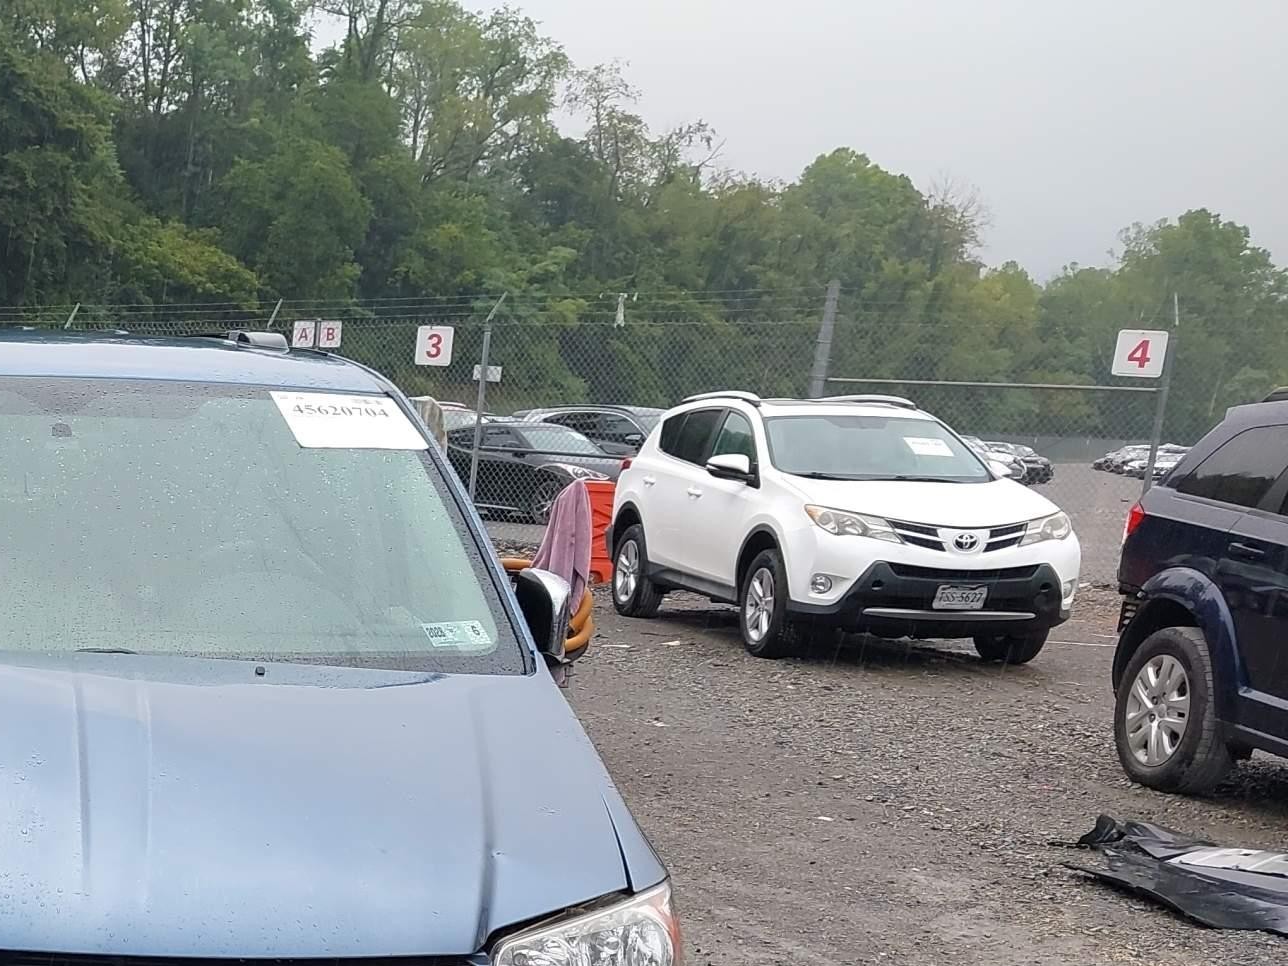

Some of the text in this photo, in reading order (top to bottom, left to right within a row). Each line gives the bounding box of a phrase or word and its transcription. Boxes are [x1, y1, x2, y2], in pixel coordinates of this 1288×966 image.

[297, 327, 309, 342] A
[325, 327, 336, 342] B
[425, 333, 442, 359] 3
[1127, 339, 1151, 369] 4
[292, 404, 390, 418] 45620704
